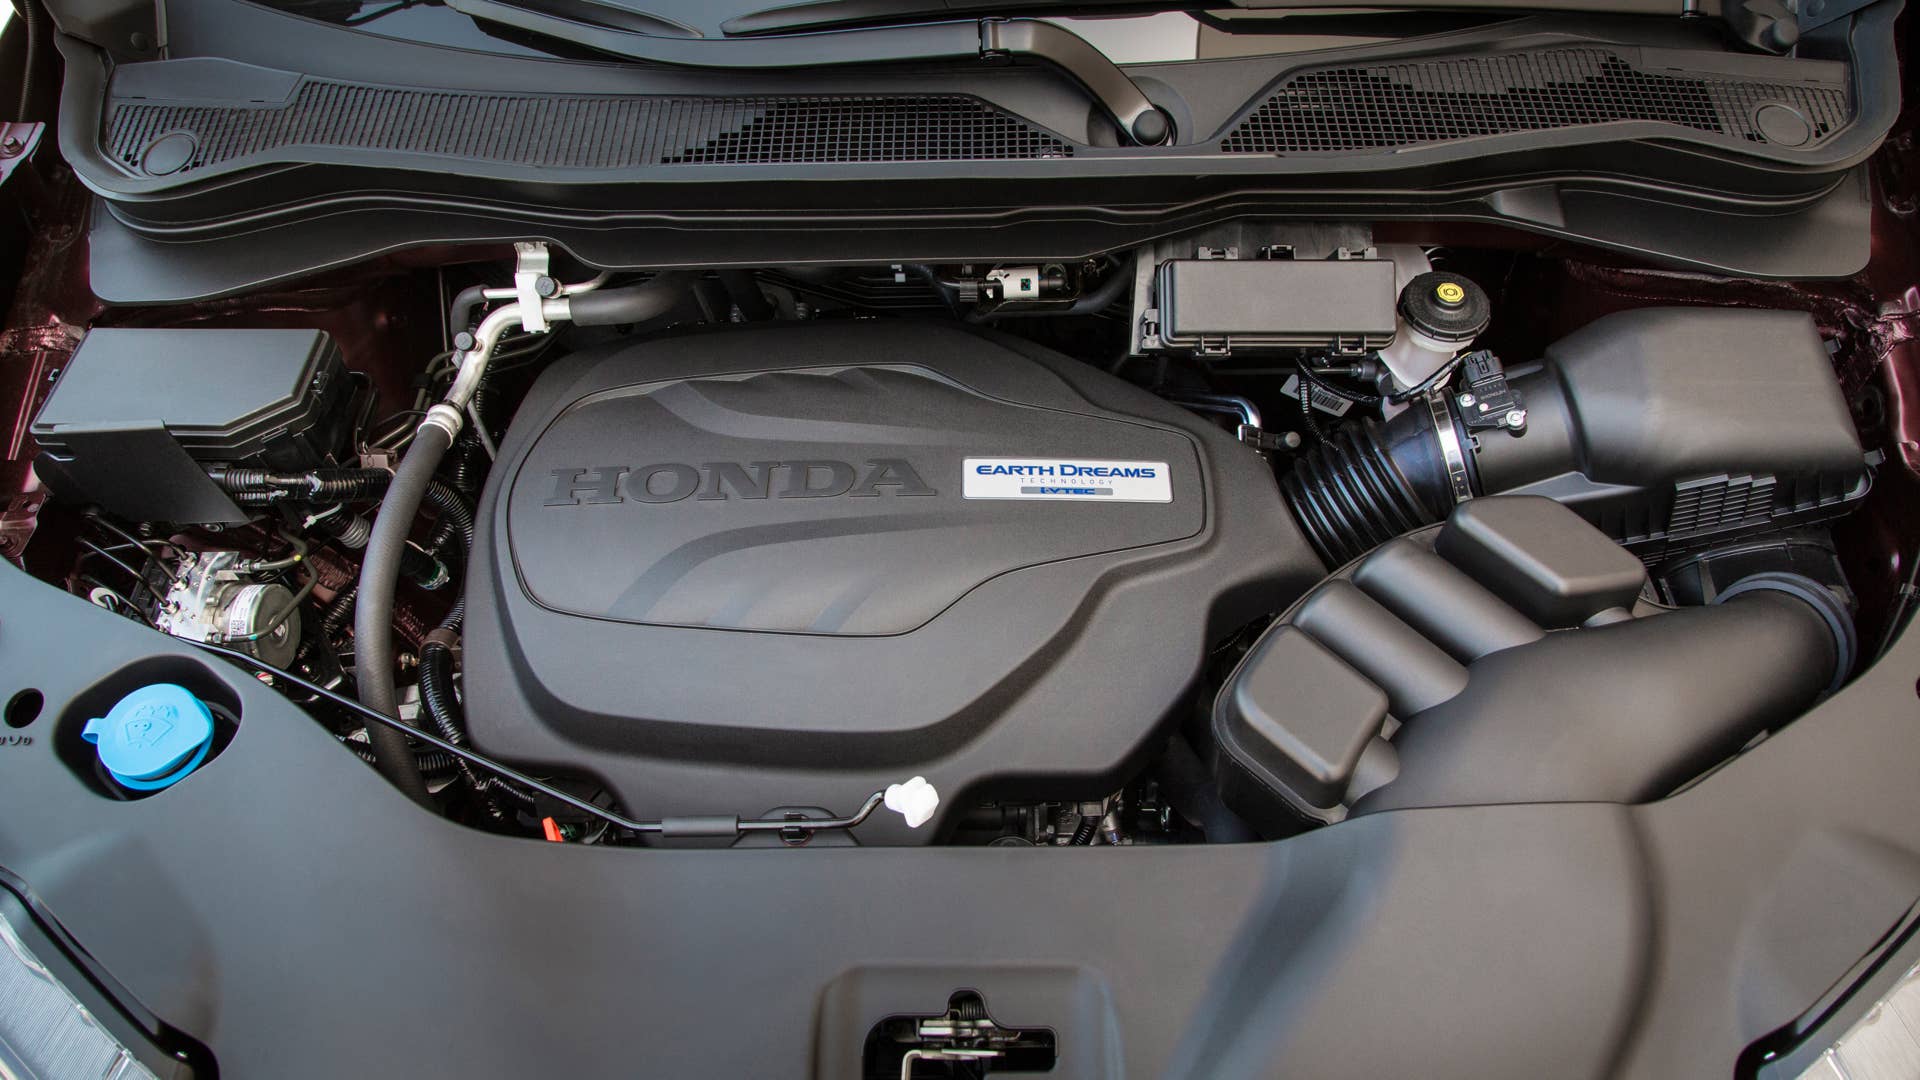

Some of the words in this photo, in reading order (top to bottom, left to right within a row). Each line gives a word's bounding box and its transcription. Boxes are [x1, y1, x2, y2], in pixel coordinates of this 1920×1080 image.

[976, 465, 1054, 476] EARTH
[1059, 464, 1156, 478] DREAMS
[543, 457, 938, 507] HONDA
[1020, 477, 1113, 485] TECHNOLOGY
